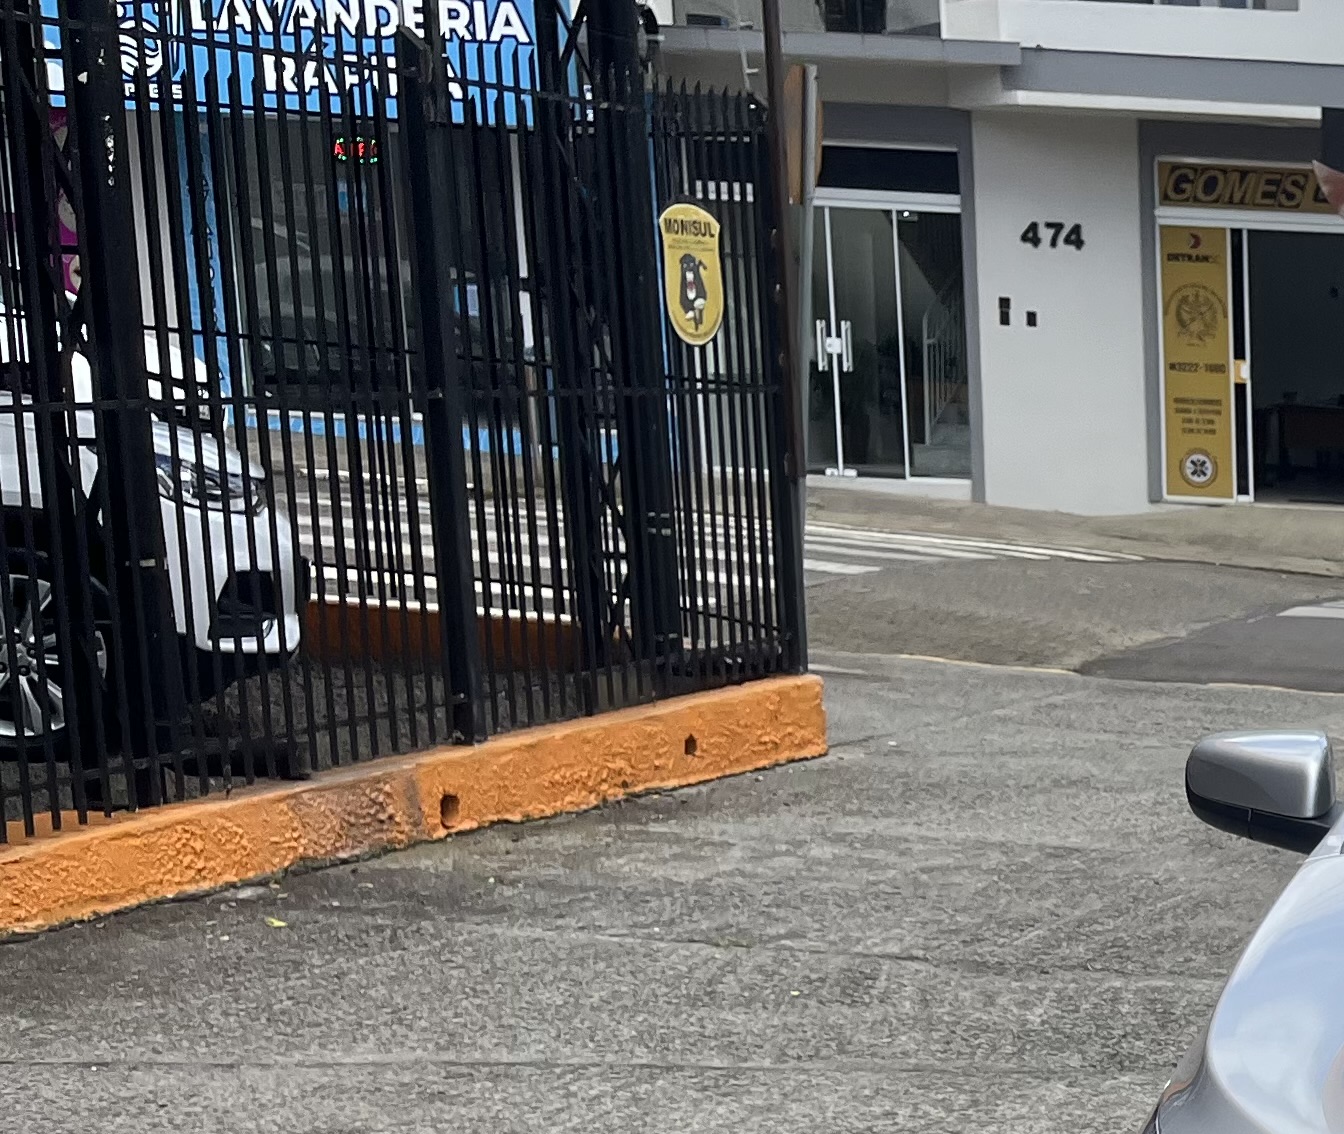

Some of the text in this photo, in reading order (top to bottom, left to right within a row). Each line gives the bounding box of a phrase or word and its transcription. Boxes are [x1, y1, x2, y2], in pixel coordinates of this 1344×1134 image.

[188, 0, 532, 44] LAVANDERIA
[1166, 166, 1306, 208] GOMES
[1020, 221, 1086, 251] 474
